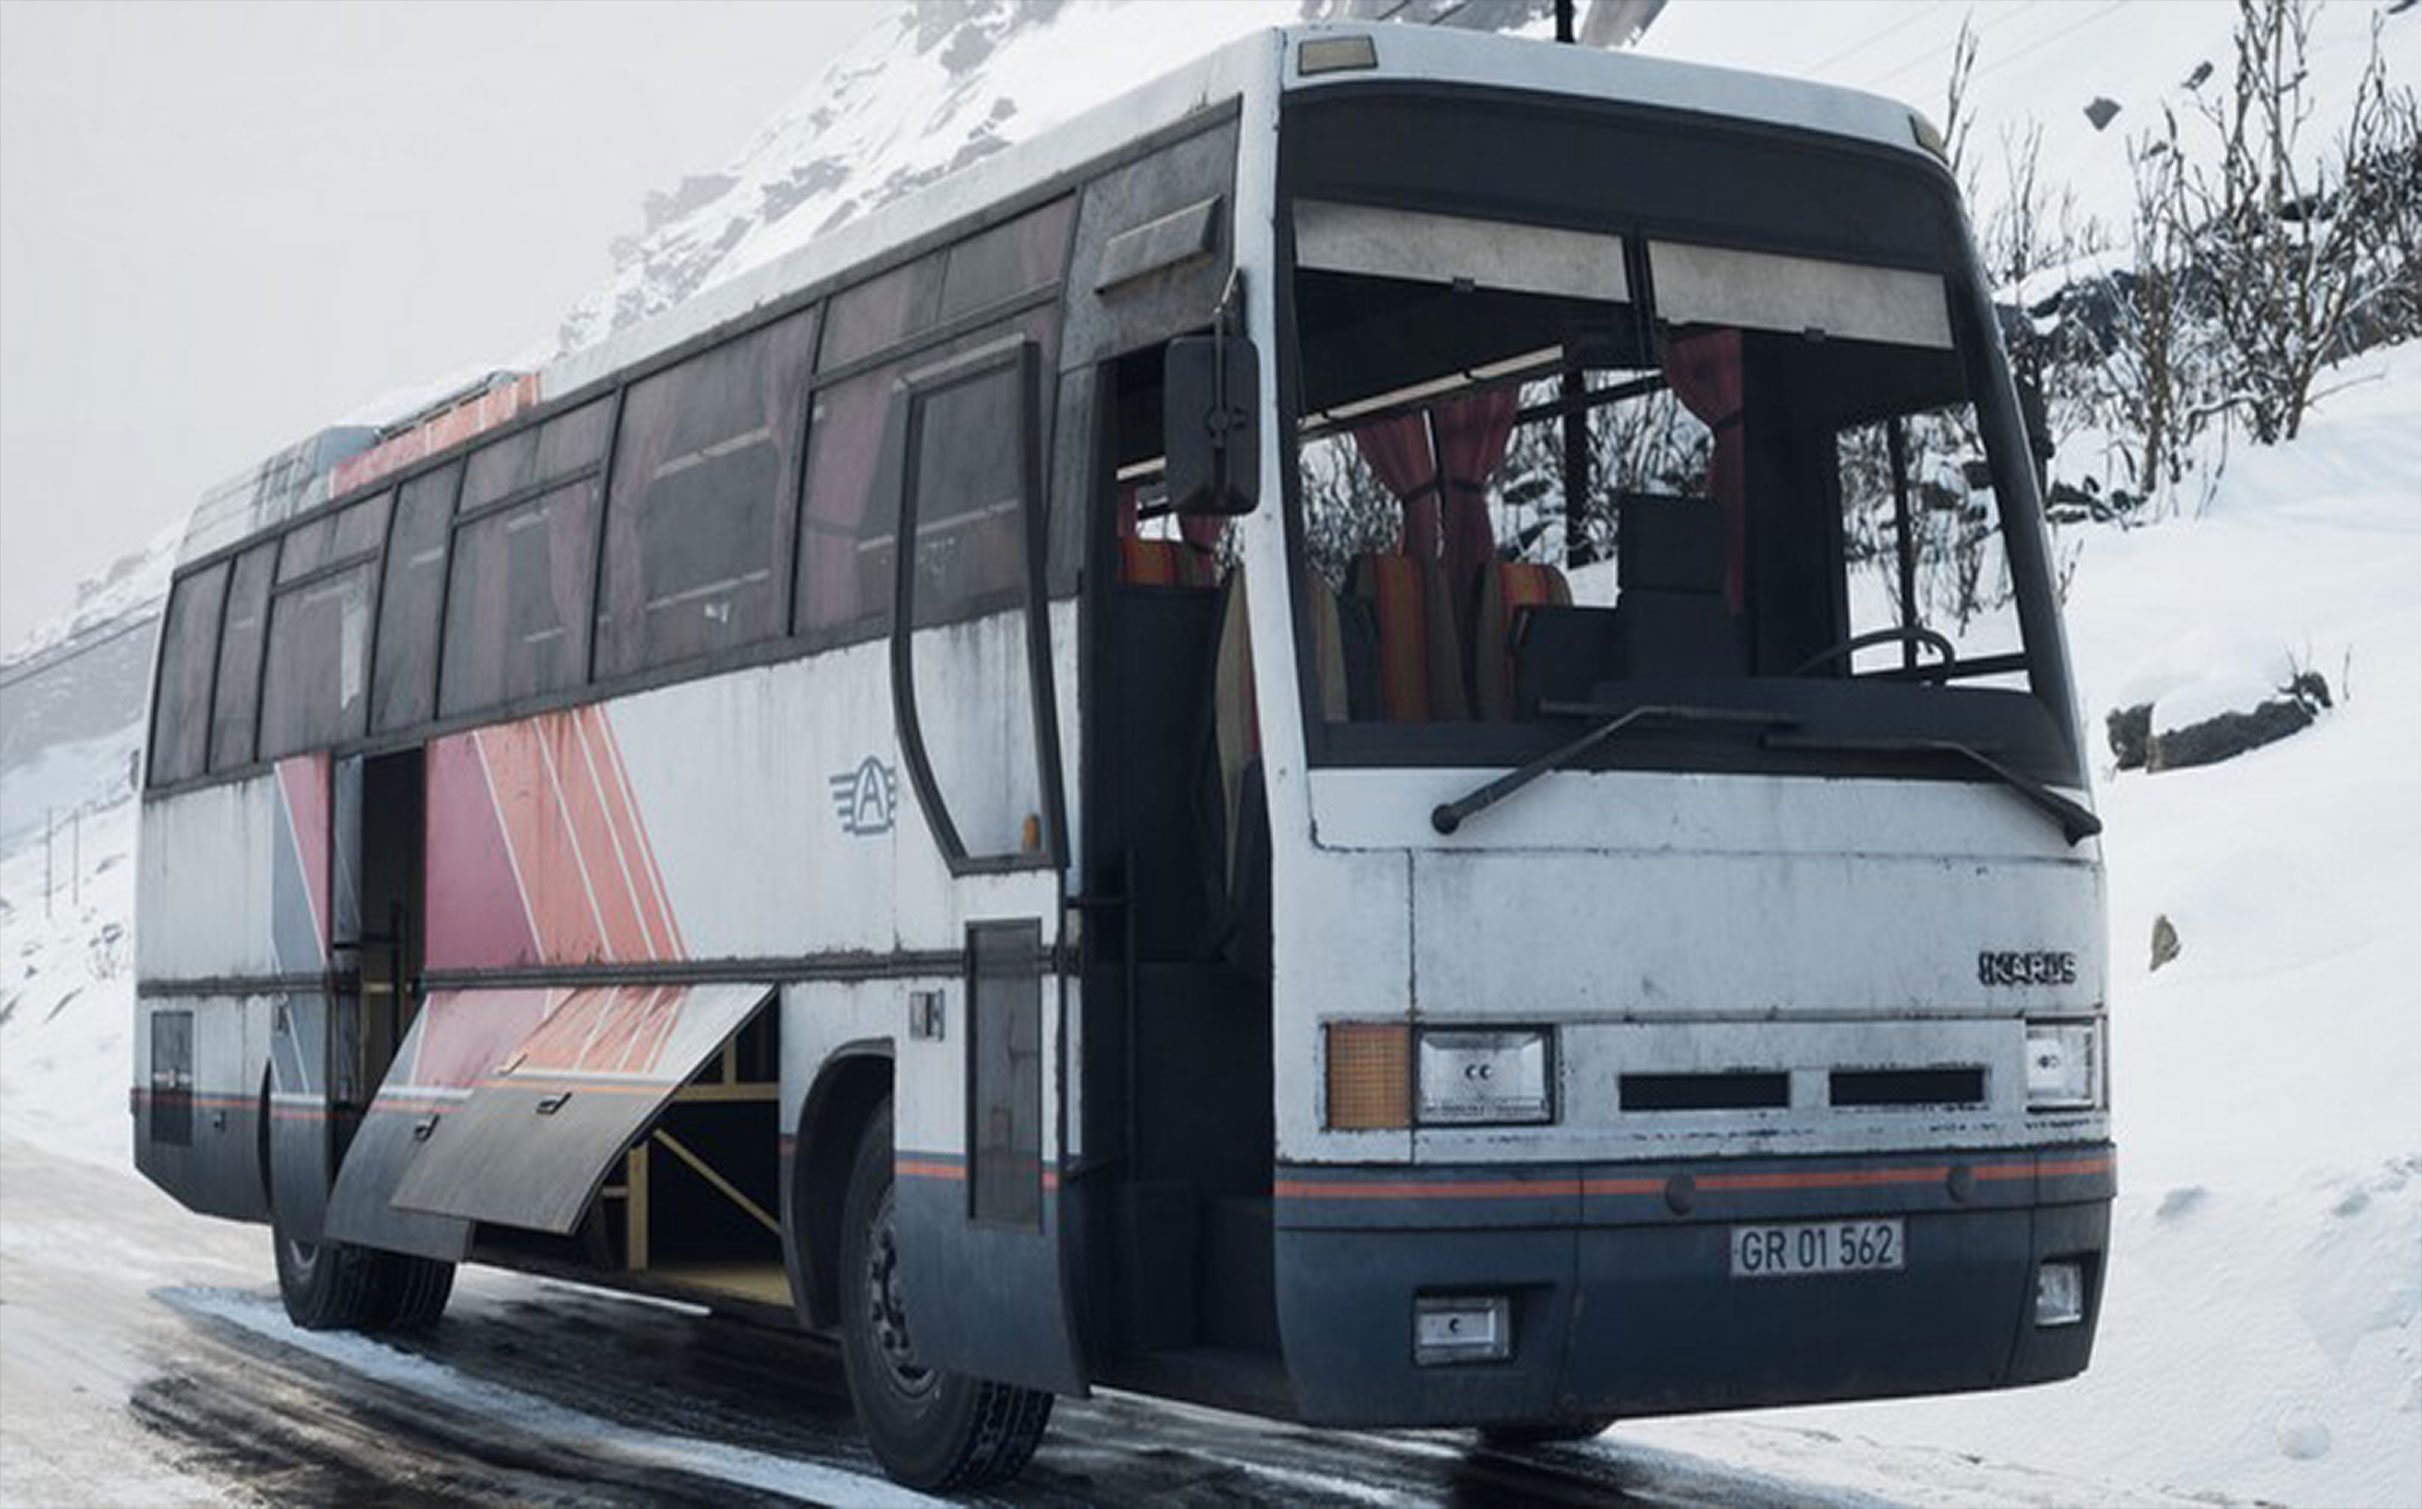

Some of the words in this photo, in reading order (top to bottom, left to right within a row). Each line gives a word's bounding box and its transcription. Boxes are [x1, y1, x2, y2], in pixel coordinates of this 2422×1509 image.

[1979, 952, 2076, 985] IKARUS
[1741, 1231, 1786, 1271] GR
[1799, 1229, 1827, 1268] 01
[1840, 1226, 1893, 1266] 562
